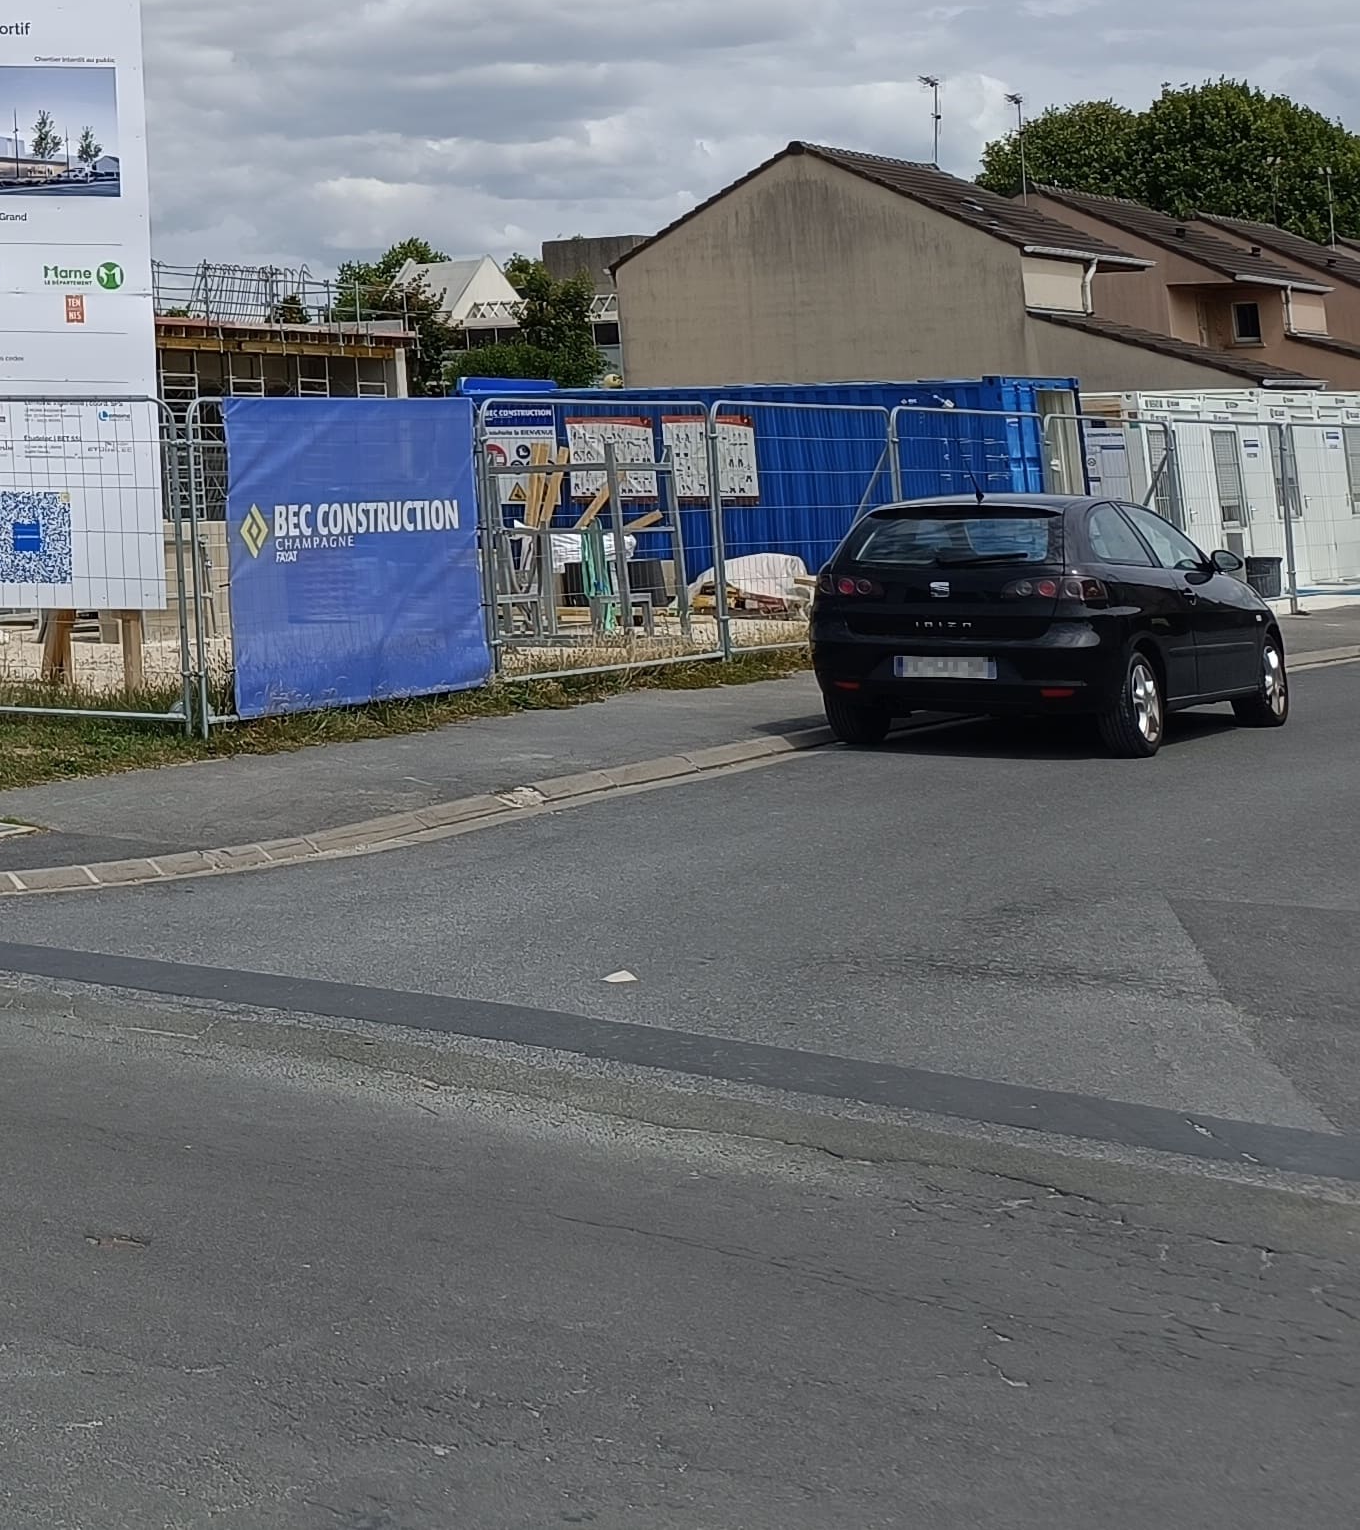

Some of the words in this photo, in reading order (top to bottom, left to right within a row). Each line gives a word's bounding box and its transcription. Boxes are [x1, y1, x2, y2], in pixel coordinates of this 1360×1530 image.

[43, 265, 92, 279] Marne
[68, 298, 81, 307] TEN
[499, 409, 551, 417] CONSTRUCTION
[274, 503, 312, 537] BEC
[317, 500, 459, 535] CONSTRUCTION
[275, 535, 355, 550] CHAMPAGNE
[276, 551, 298, 562] FAYAT
